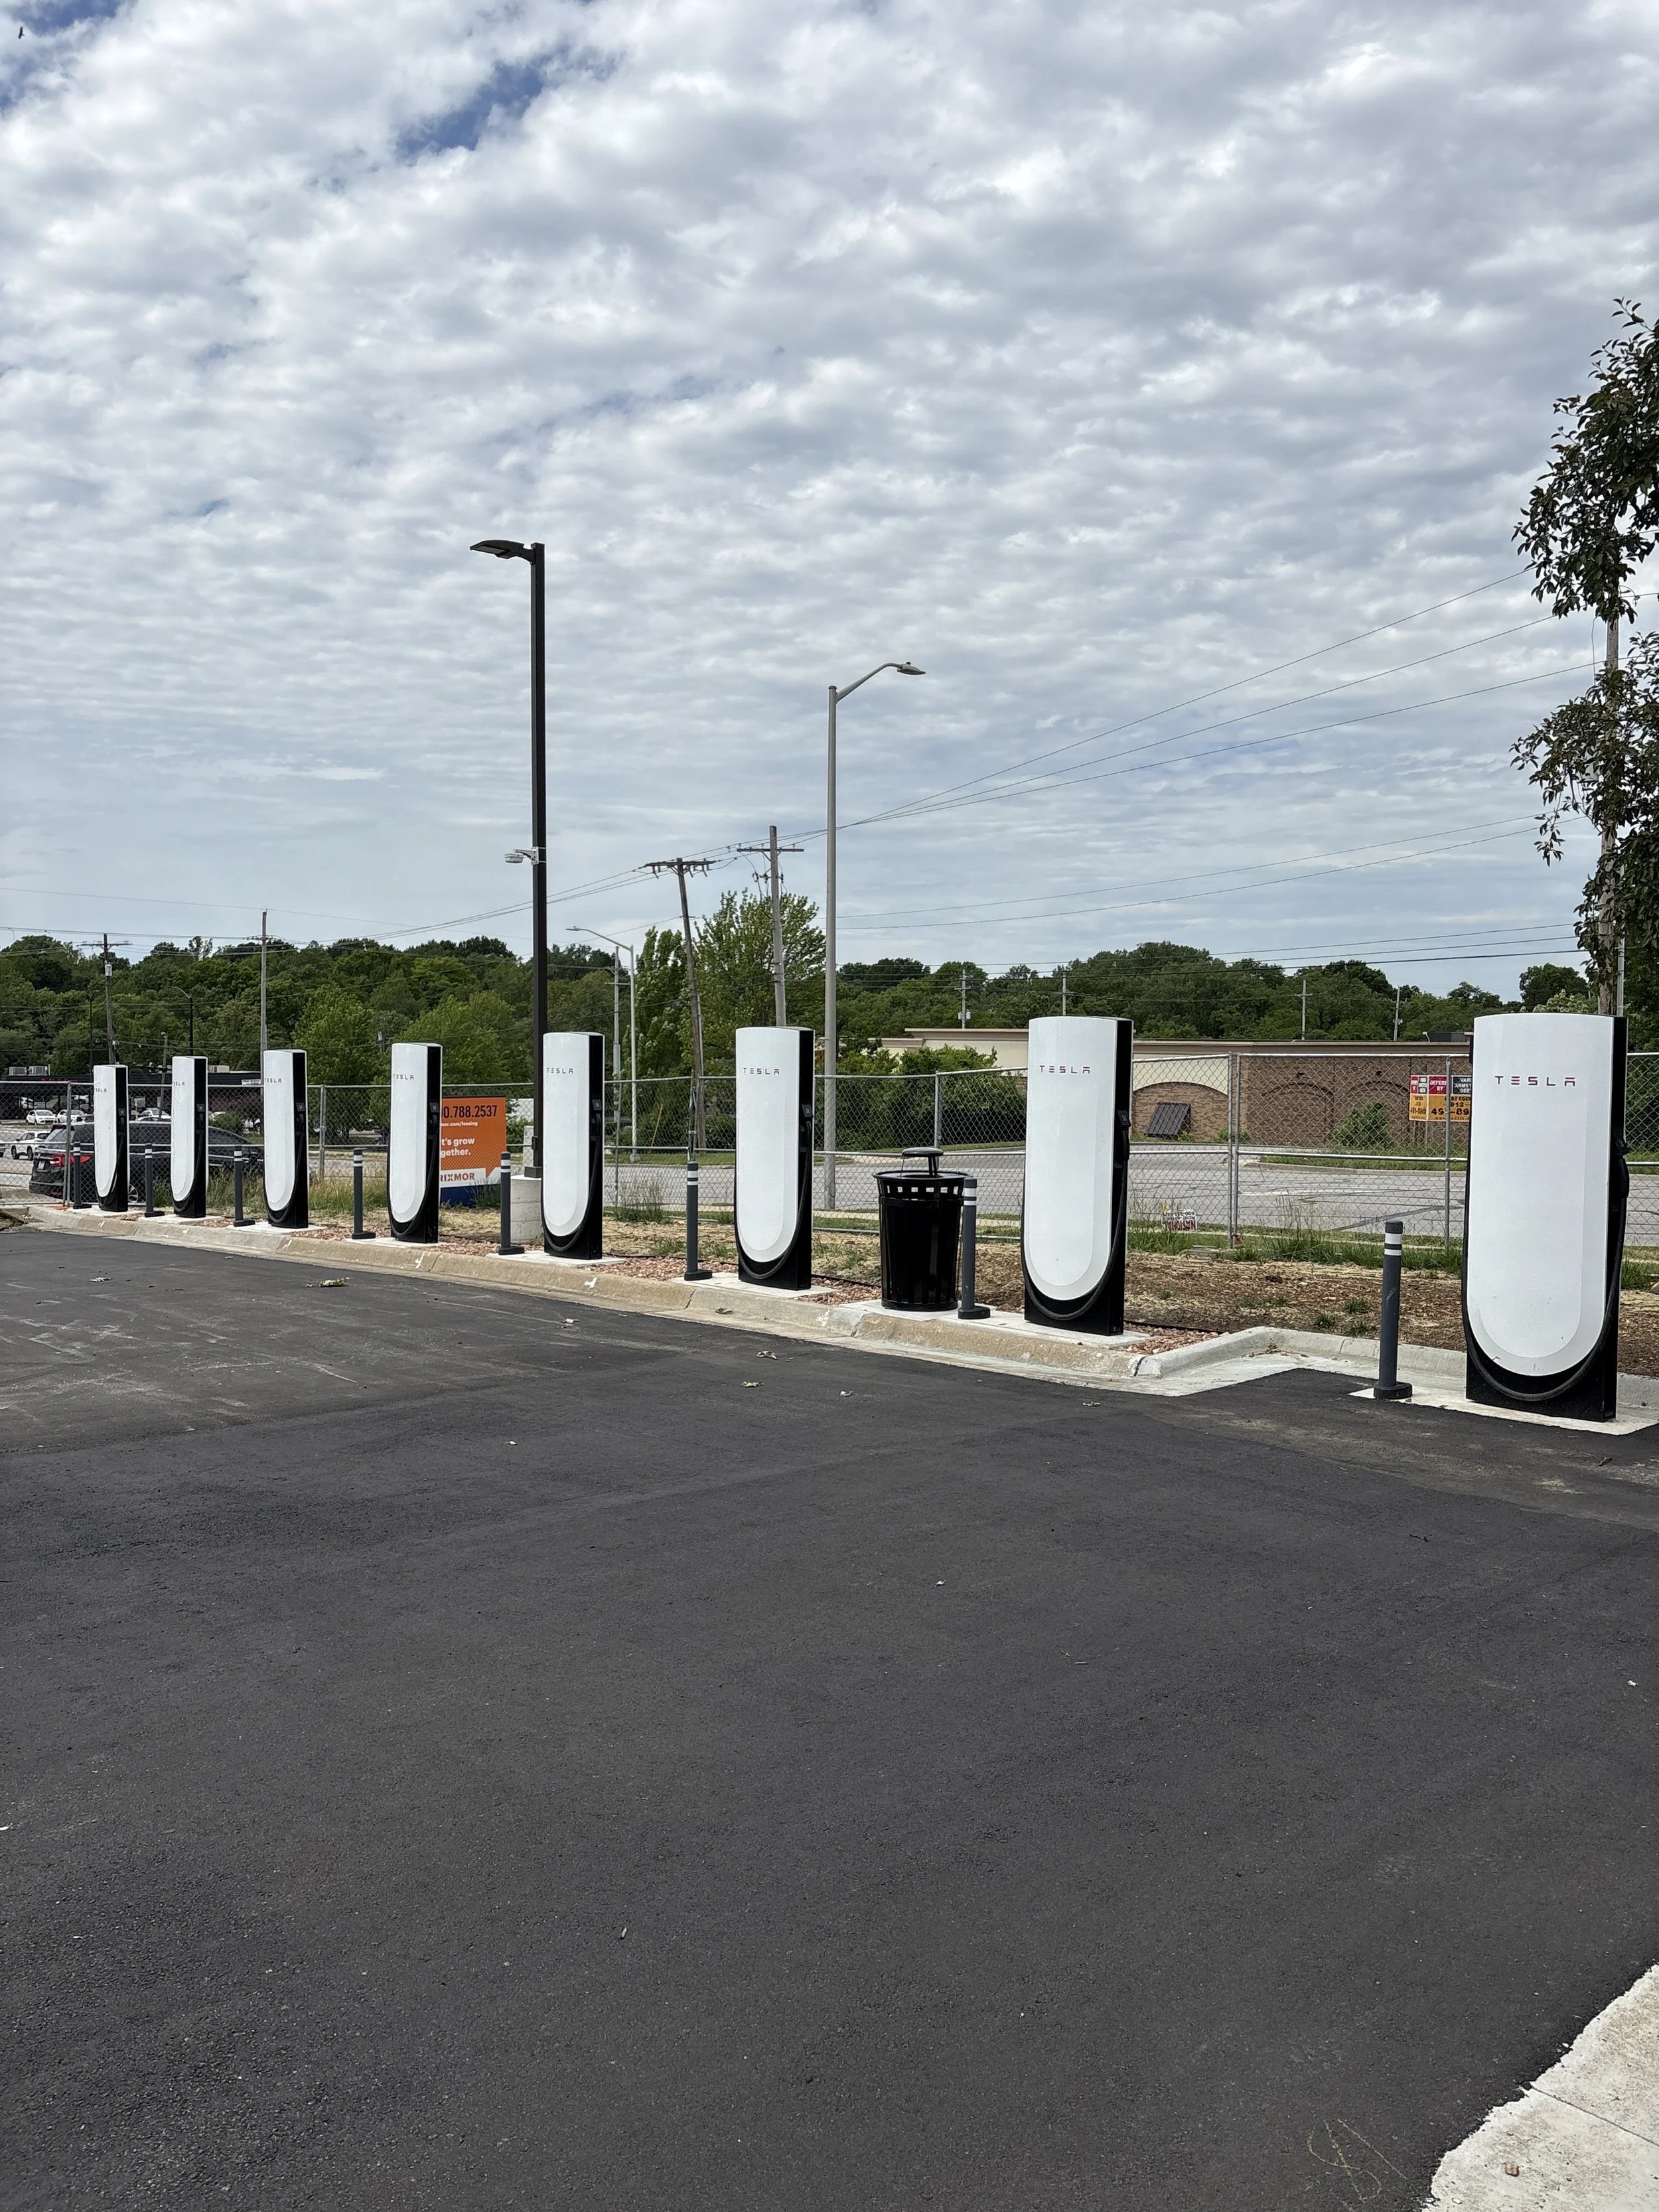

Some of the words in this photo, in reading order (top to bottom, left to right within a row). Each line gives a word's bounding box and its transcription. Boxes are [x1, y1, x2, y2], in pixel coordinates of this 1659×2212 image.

[1039, 1065, 1091, 1074] TESLA
[1494, 1075, 1575, 1087] TESLA
[441, 1104, 498, 1119] 0.788.2537
[453, 1138, 475, 1147] grow
